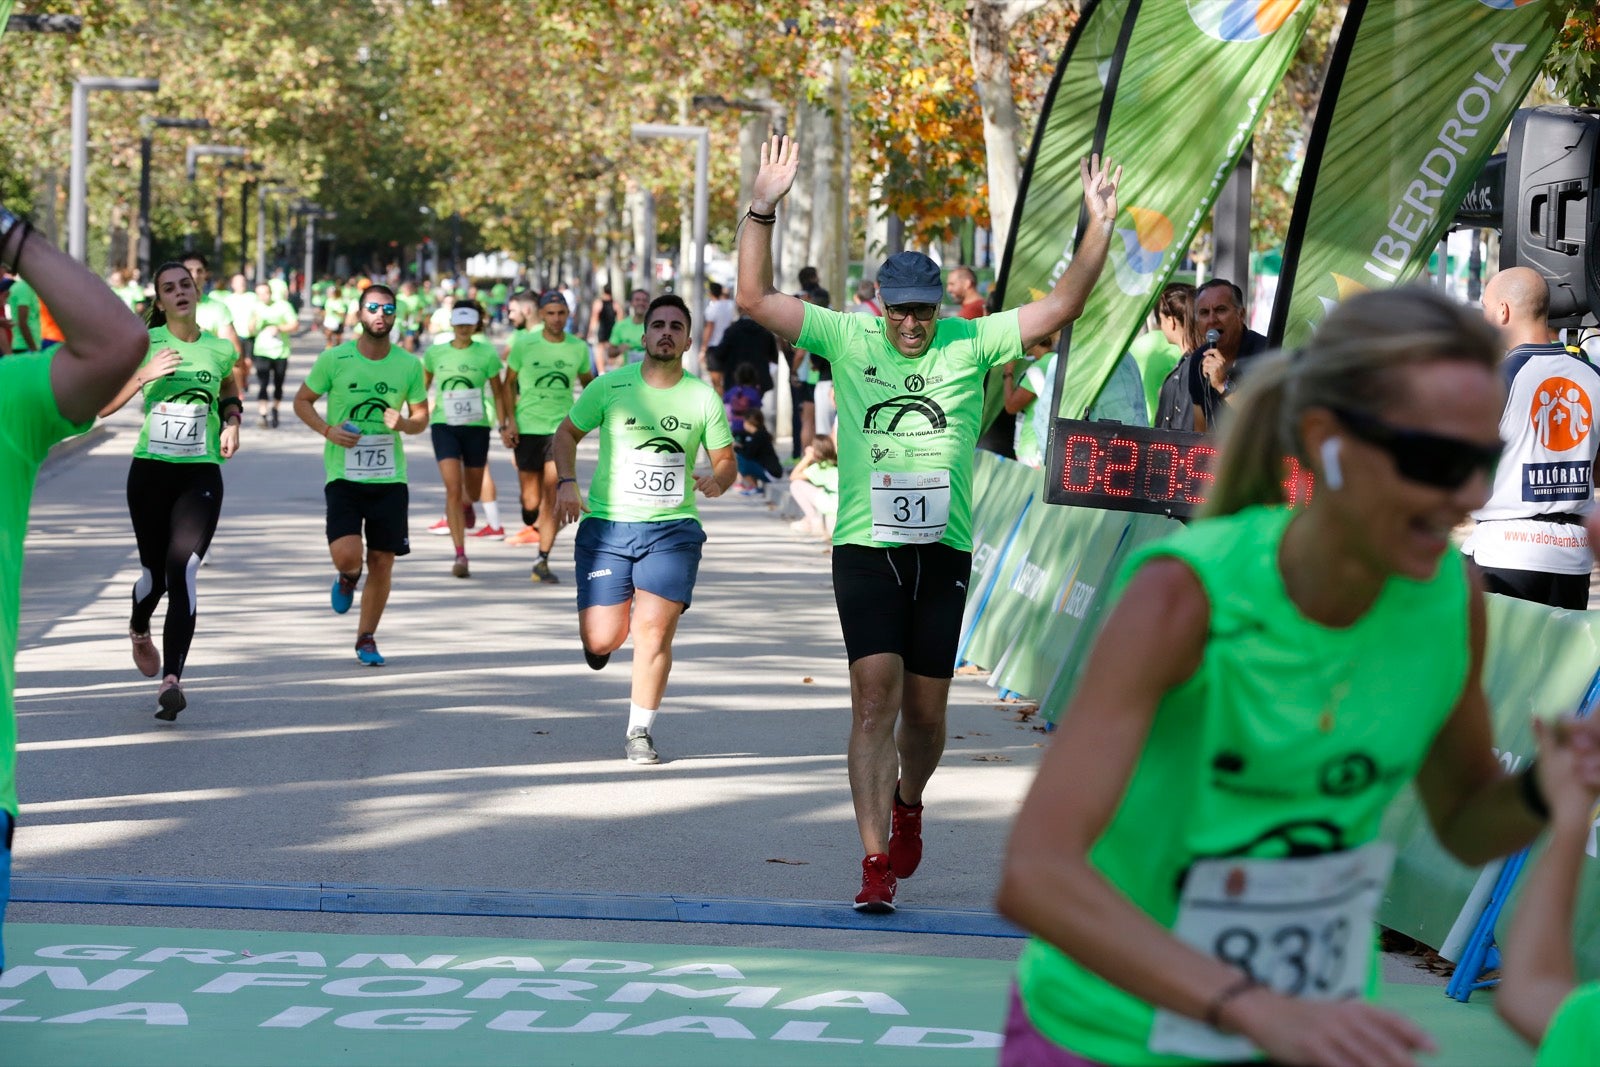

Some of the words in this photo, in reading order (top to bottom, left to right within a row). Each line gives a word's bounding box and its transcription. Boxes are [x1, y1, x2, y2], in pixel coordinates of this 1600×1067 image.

[1363, 42, 1527, 283] IBERDROLA
[454, 402, 472, 415] 94
[161, 420, 198, 441] 174
[354, 449, 387, 467] 175
[1063, 434, 1217, 503] 0:27:5
[633, 469, 676, 492] 356
[893, 495, 926, 523] 31
[1504, 530, 1589, 548] www.valoratemas.co
[34, 943, 746, 980] GRANADA
[0, 965, 155, 991] N
[193, 971, 910, 1016] FORMA
[258, 1004, 1005, 1048] IGUALD
